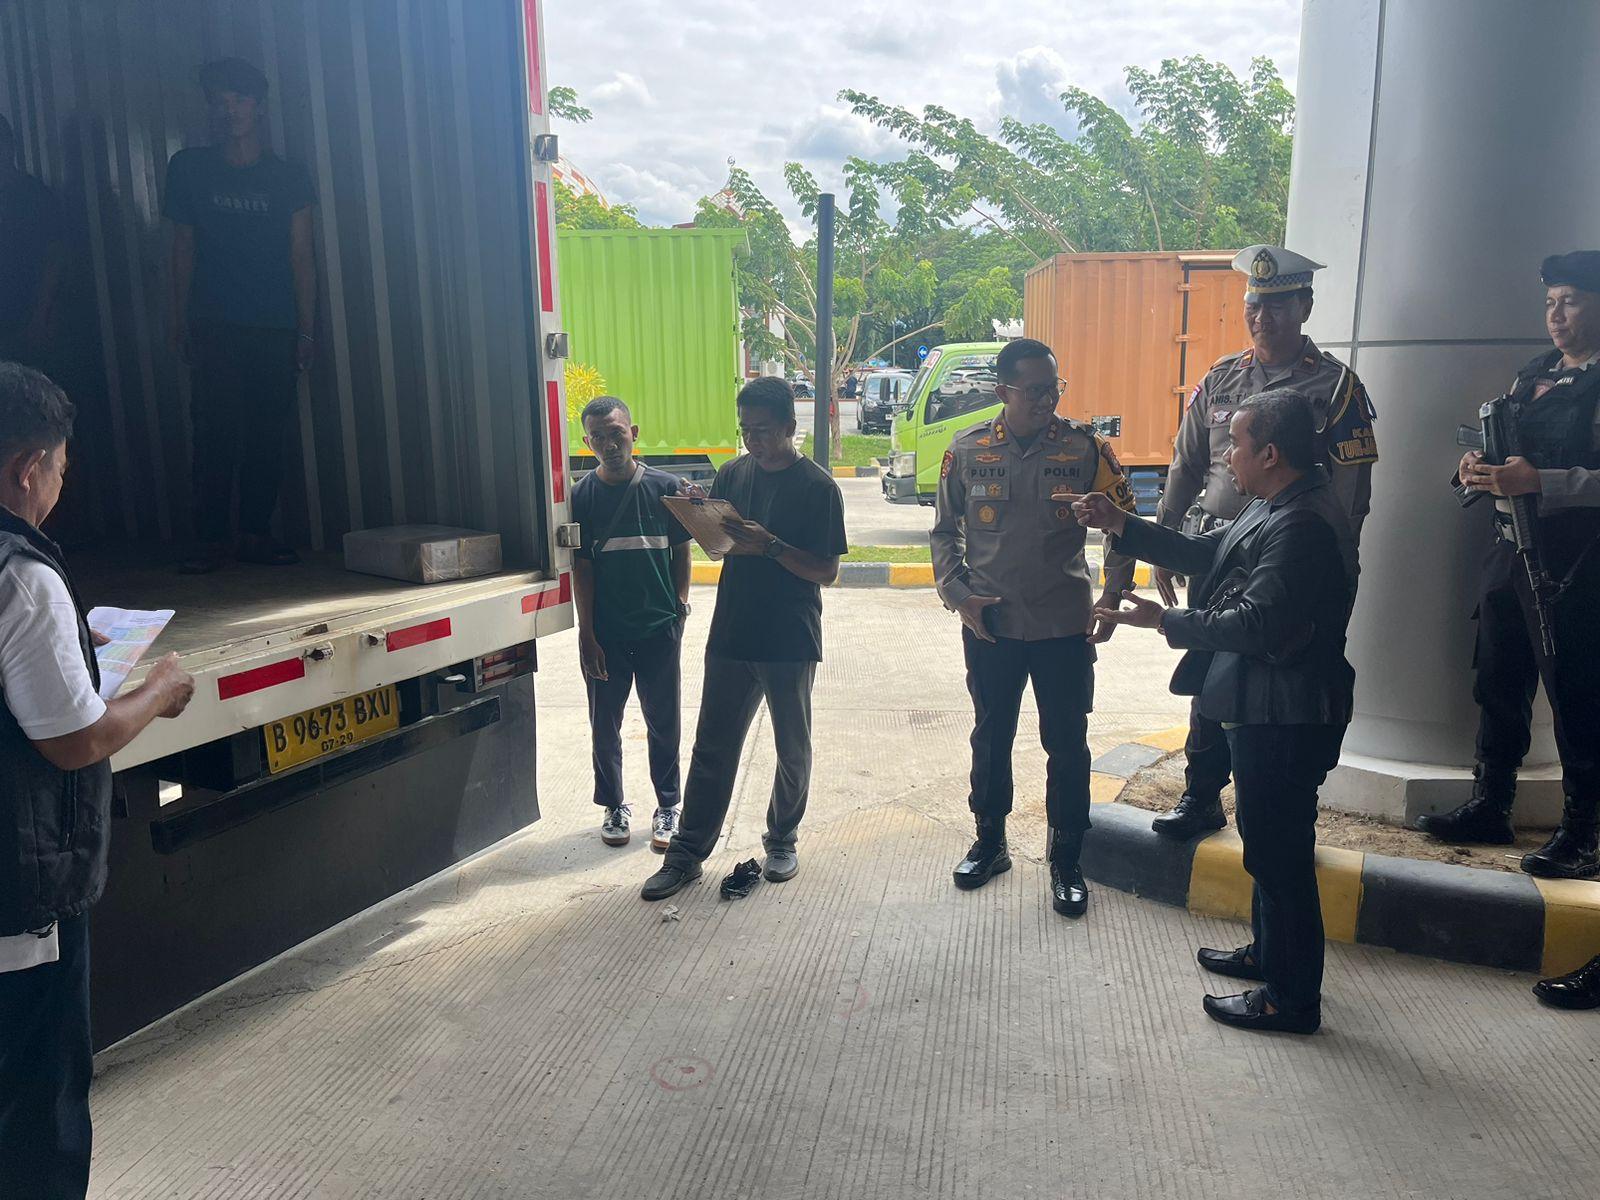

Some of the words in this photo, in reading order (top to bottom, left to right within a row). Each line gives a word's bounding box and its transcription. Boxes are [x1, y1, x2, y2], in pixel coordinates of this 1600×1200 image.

[970, 467, 1006, 478] PUTU
[1044, 467, 1081, 478] POLRI
[272, 722, 288, 753] B
[293, 702, 347, 745] 9673
